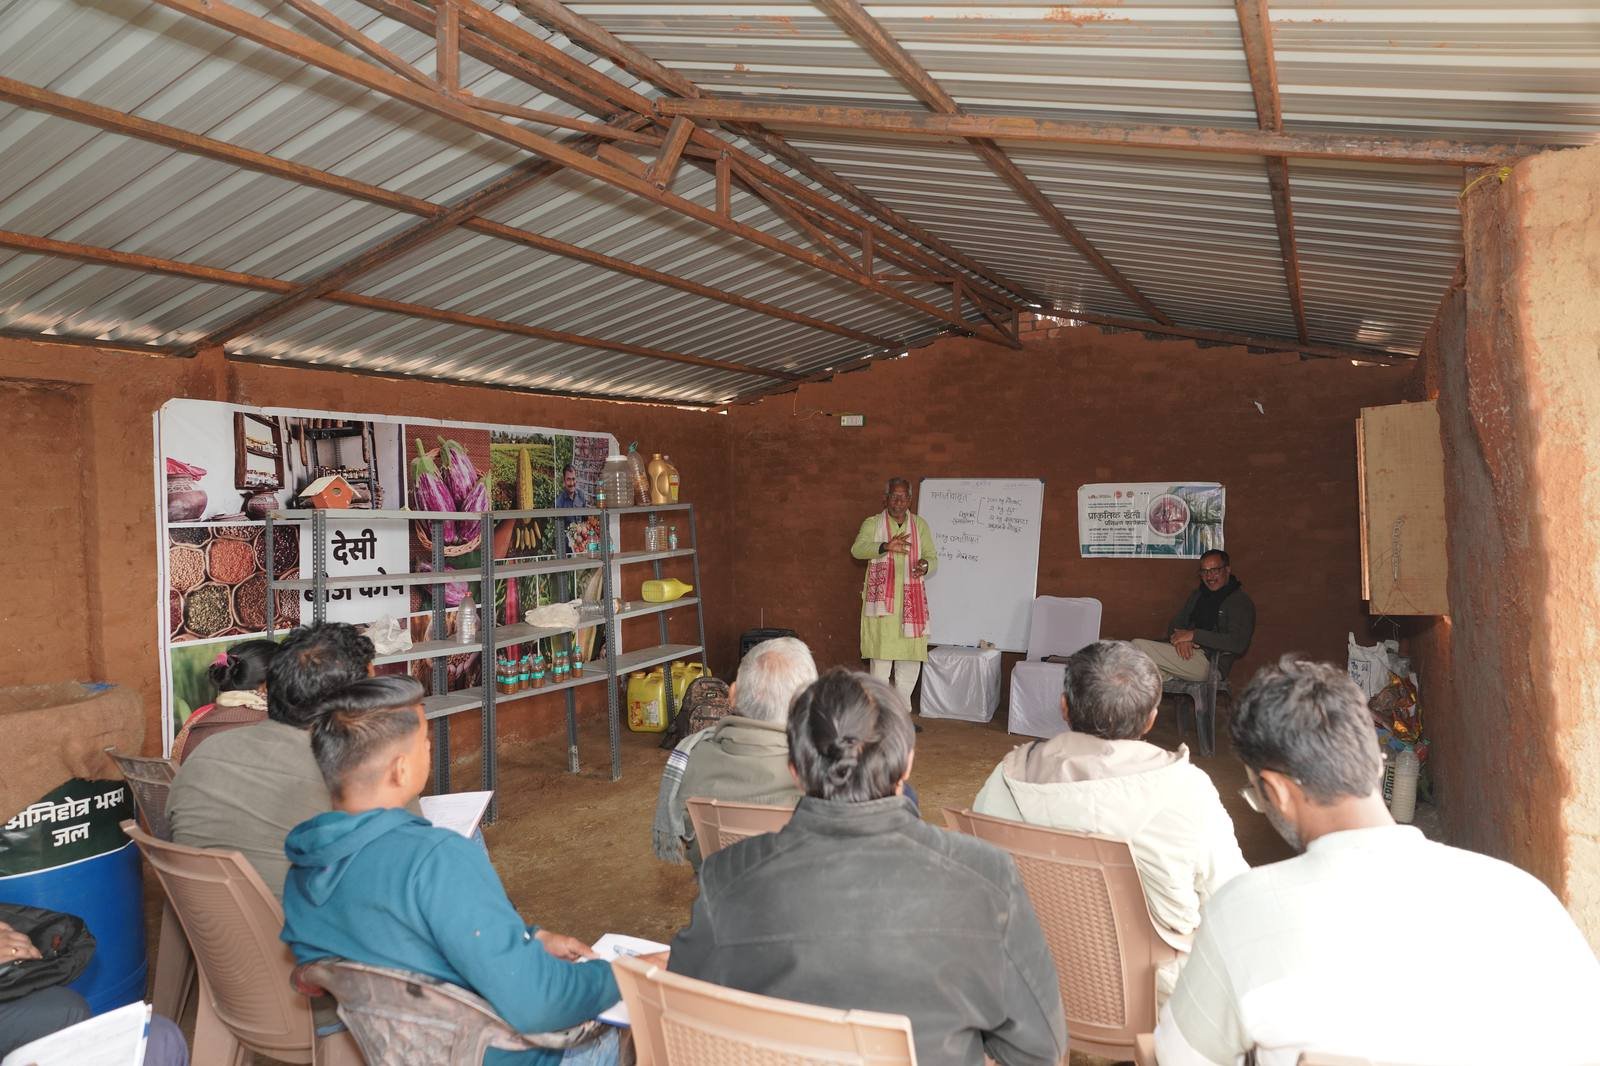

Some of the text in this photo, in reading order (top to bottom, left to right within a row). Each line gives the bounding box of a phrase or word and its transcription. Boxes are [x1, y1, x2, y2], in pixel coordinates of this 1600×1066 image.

[1088, 509, 1141, 522] प्राकृतिक खेती
[331, 528, 378, 566] देसी
[5, 796, 91, 831] अग्निहोत्र
[52, 822, 91, 847] जल
